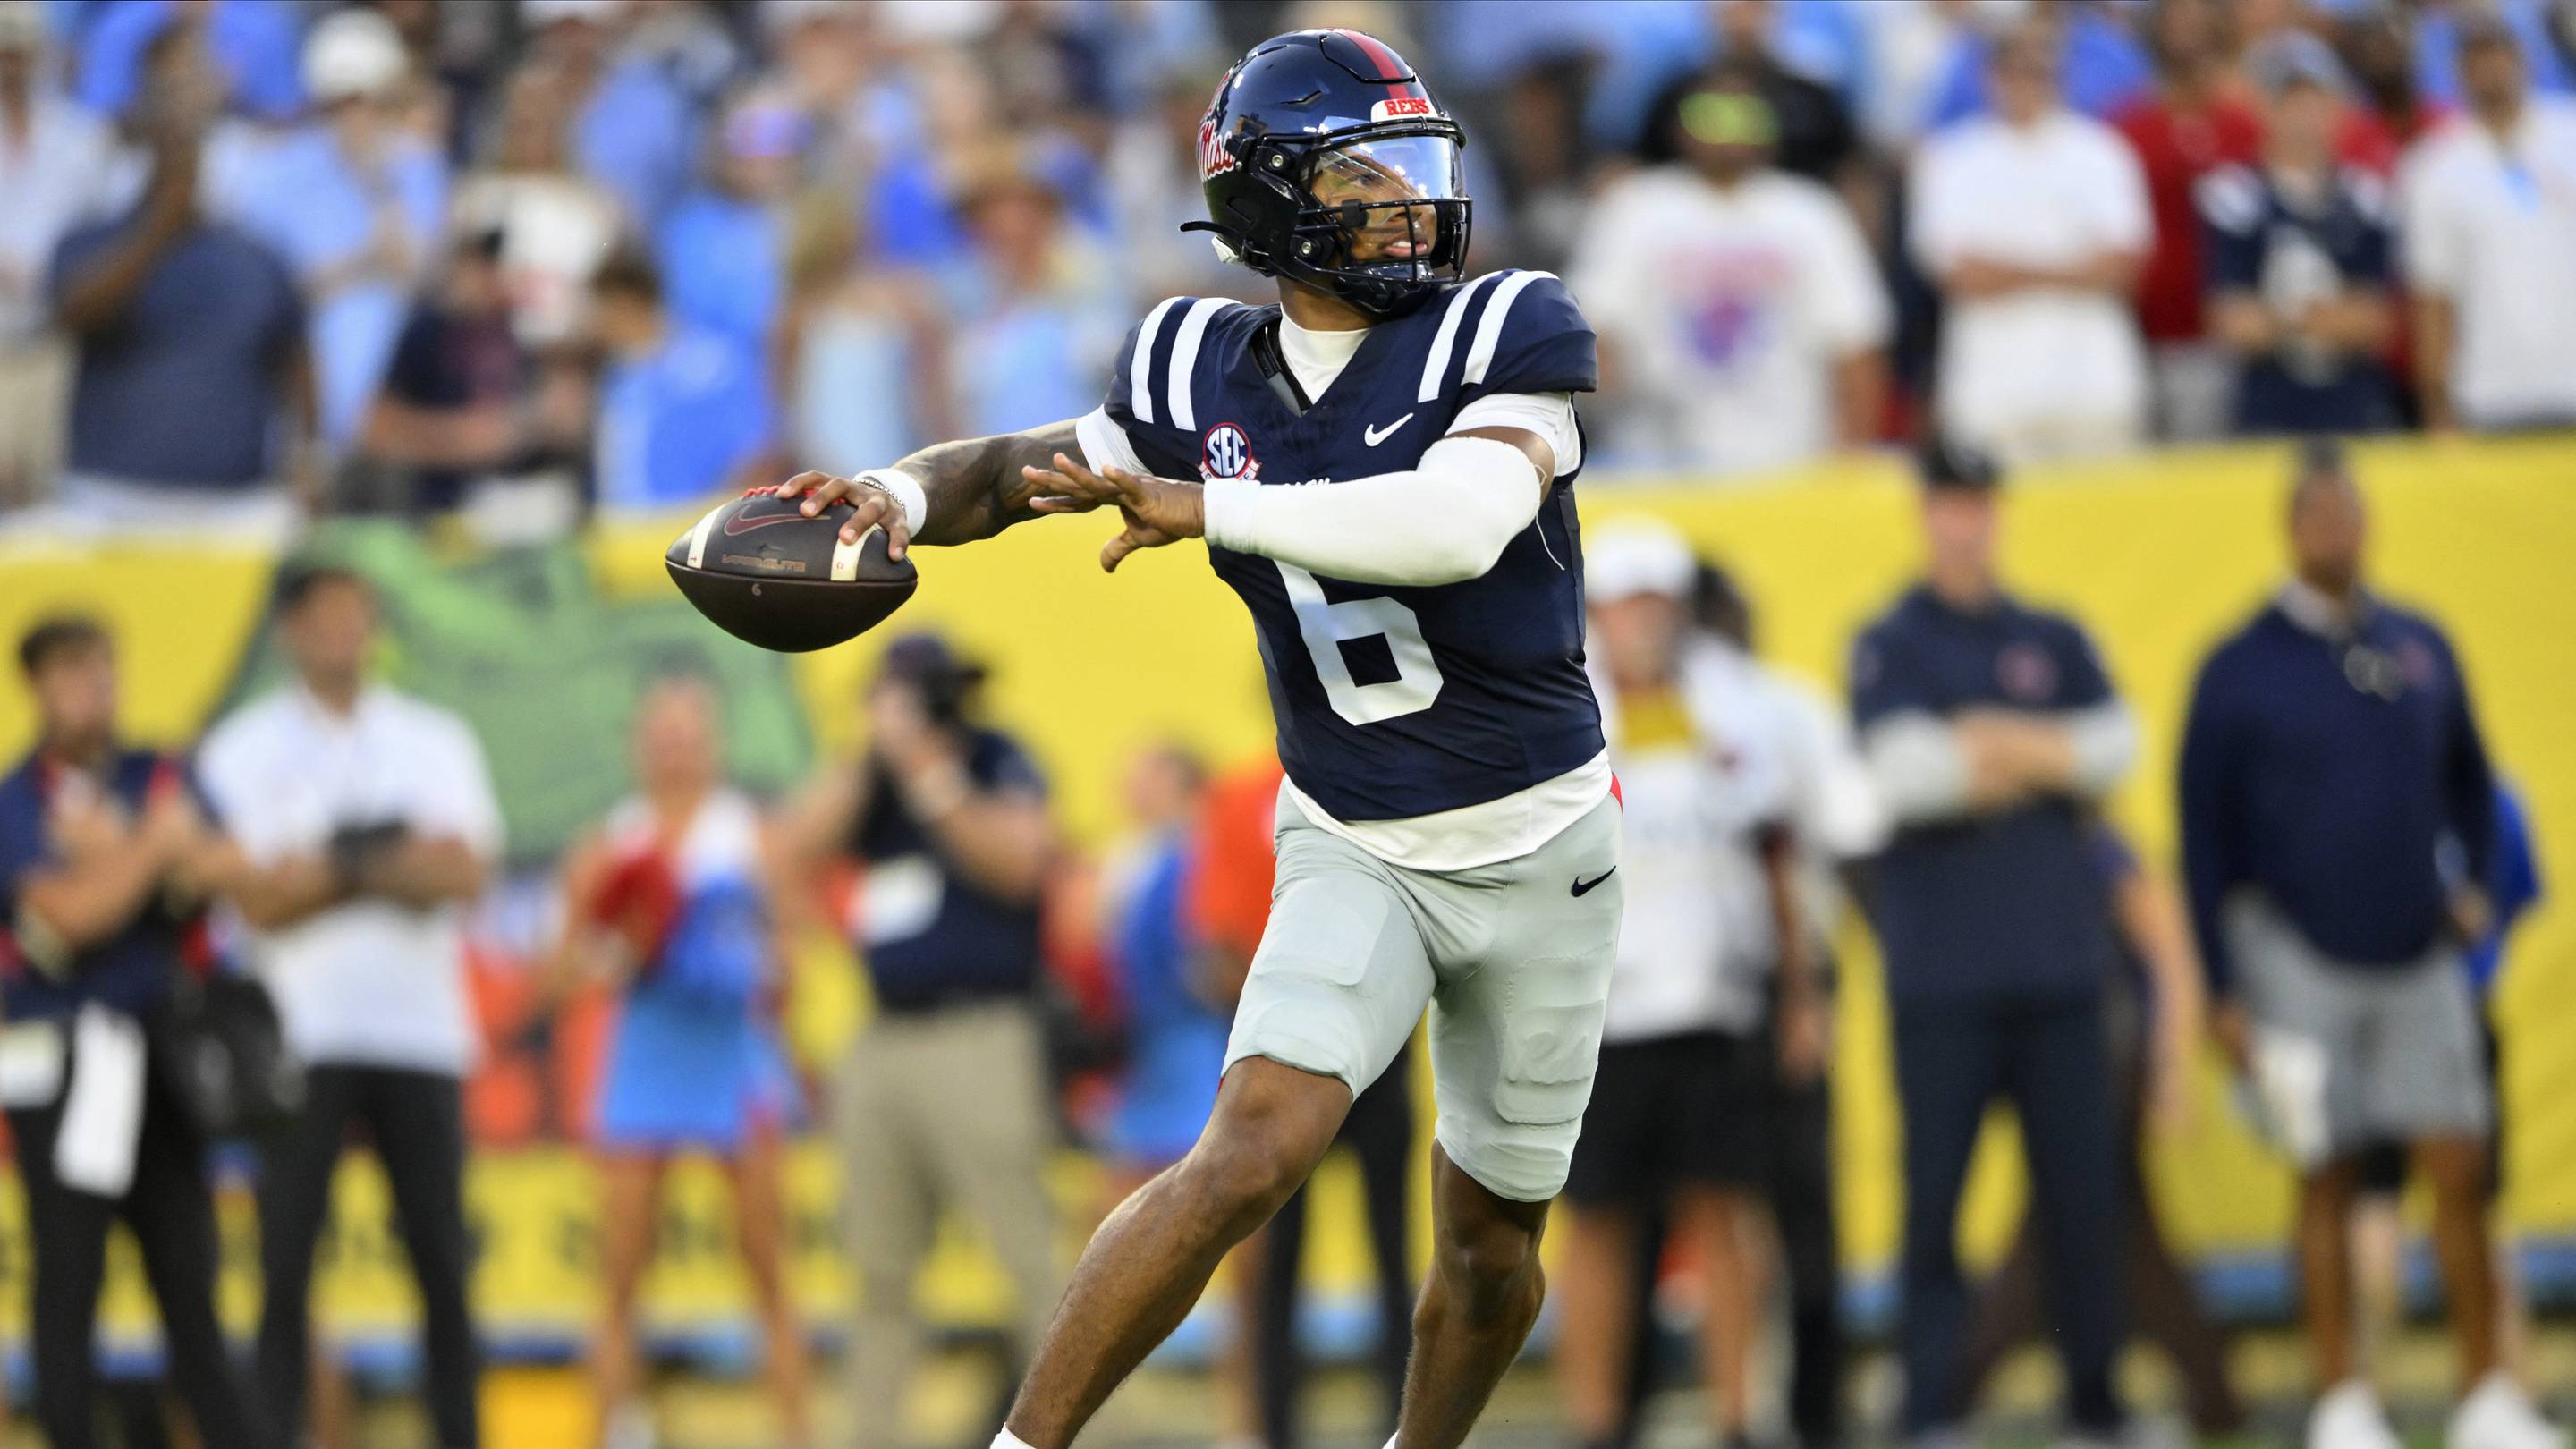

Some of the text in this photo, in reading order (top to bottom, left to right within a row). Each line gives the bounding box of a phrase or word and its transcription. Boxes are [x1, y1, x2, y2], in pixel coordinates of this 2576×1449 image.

[1384, 98, 1429, 116] REBS
[1207, 427, 1246, 477] SEC
[751, 582, 762, 597] 6
[1274, 558, 1444, 726] 6
